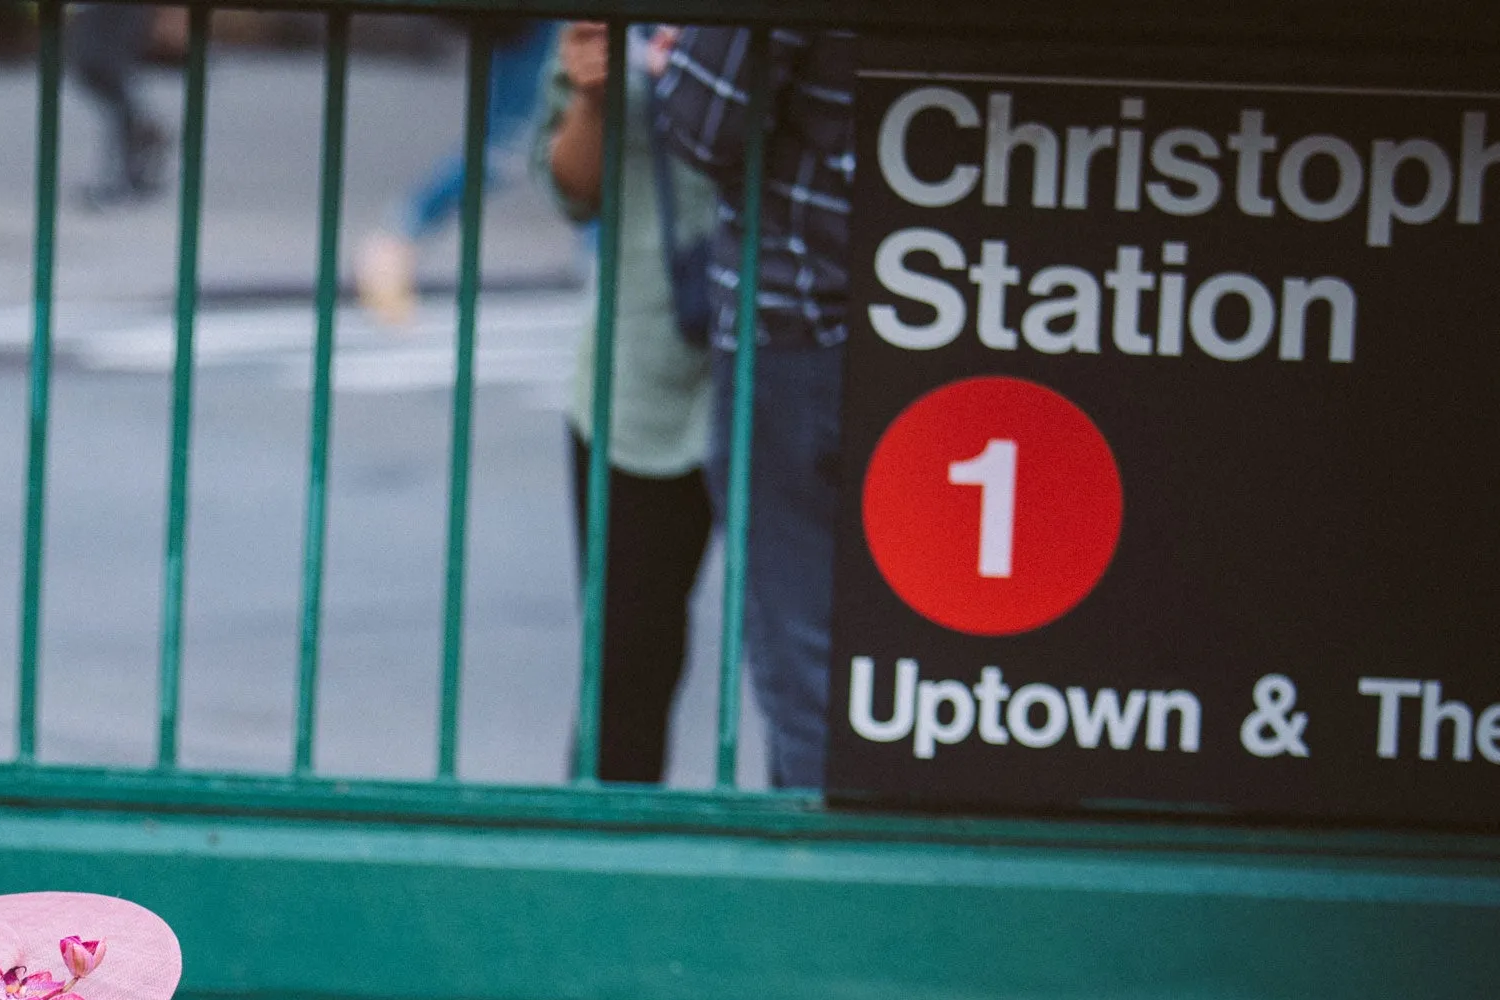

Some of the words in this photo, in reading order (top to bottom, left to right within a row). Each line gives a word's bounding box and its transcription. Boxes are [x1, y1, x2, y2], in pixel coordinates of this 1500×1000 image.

[877, 86, 1500, 248] Christoph
[867, 227, 1357, 363] Station
[947, 439, 1018, 578] 1
[848, 655, 1201, 760] Uptown
[1239, 673, 1310, 759] &
